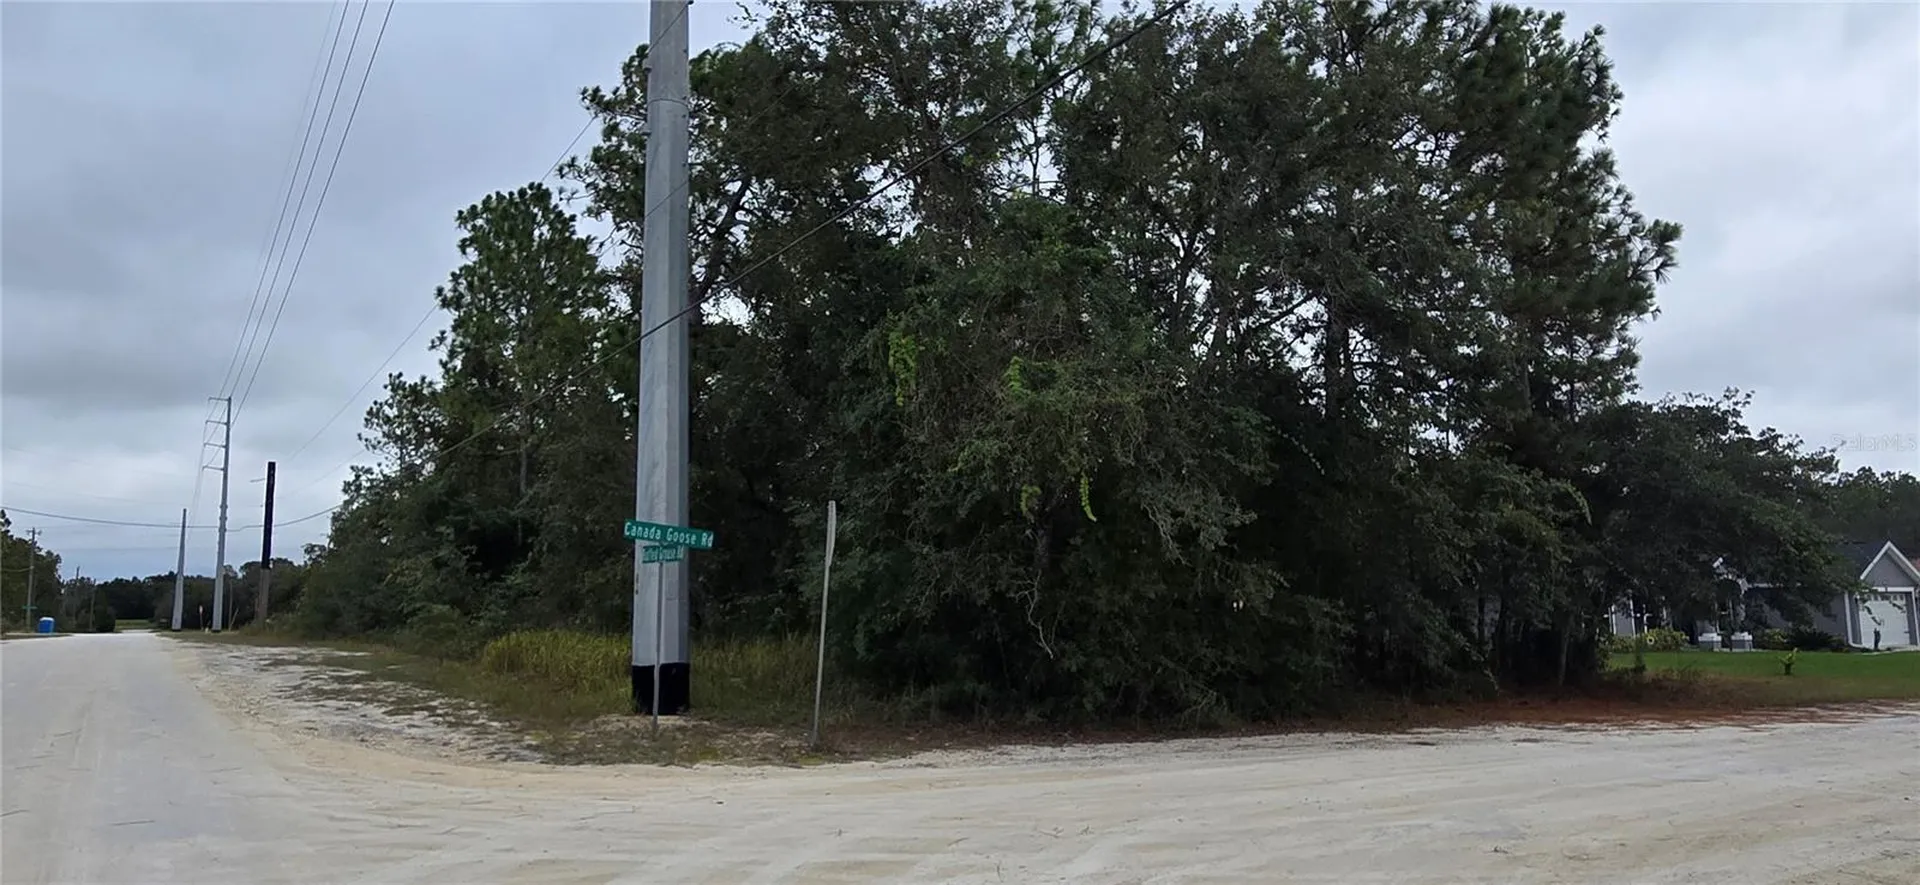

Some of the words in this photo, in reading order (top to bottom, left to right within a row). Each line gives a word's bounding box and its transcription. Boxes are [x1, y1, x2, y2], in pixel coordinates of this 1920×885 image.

[624, 522, 661, 540] Canada
[666, 528, 697, 545] Goose
[701, 532, 714, 548] Rd
